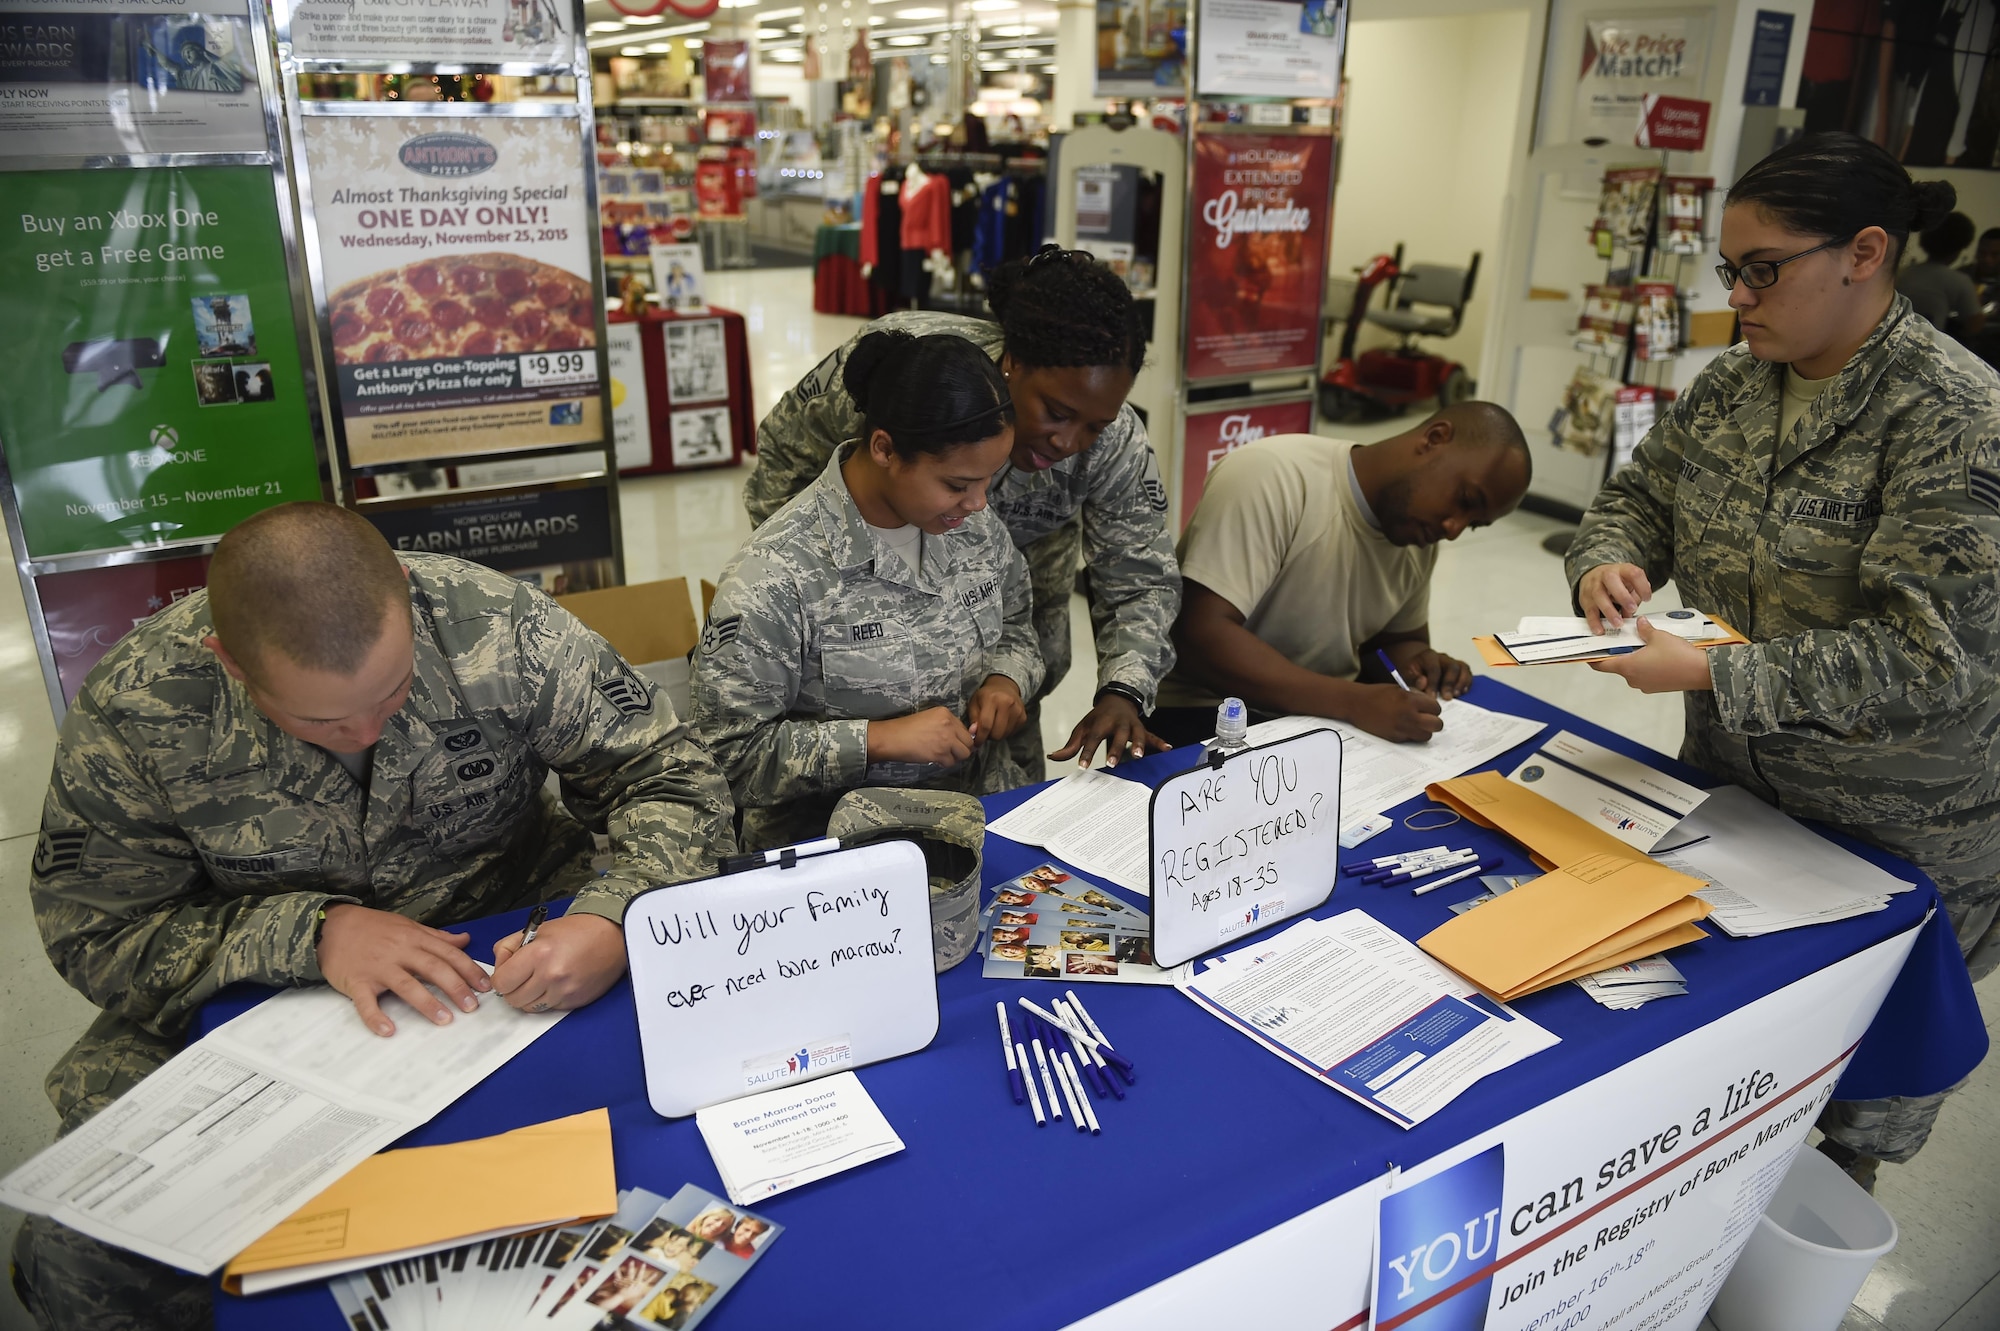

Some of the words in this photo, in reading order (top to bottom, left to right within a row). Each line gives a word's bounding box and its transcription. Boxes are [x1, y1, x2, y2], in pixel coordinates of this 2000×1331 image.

[23, 26, 76, 41] EARN
[1634, 33, 1686, 55] Price
[0, 43, 74, 58] WARDS
[1595, 51, 1684, 77] Match!
[19, 89, 49, 99] NOW
[26, 100, 71, 108] RECEIVING
[404, 145, 495, 165] ANTHONY'S
[431, 165, 469, 176] PIZZA
[1223, 169, 1303, 185] EXTENDED
[332, 188, 396, 205] Almost
[399, 186, 509, 205] Thanksgiving
[513, 185, 568, 202] Special
[1242, 187, 1288, 203] PRICE
[21, 214, 66, 236] Buy
[74, 215, 102, 231] an
[108, 209, 167, 230] Xbox
[172, 208, 219, 228] One
[358, 209, 414, 229] ONE
[421, 208, 468, 228] DAY
[477, 206, 549, 225] ONLY!
[1203, 190, 1311, 250] Guarantee
[340, 233, 433, 250] Wednesday,
[436, 230, 511, 245] November
[515, 230, 535, 244] 25,
[538, 228, 568, 242] 2015
[36, 250, 75, 272] get
[82, 249, 94, 266] a
[102, 245, 153, 265] Free
[159, 244, 225, 263] Game
[353, 367, 380, 381] Get
[382, 369, 391, 379] a
[392, 365, 431, 380] Large
[432, 357, 517, 375] One-Topping
[528, 354, 584, 375] $9.99
[356, 380, 426, 397] Anthony's
[427, 377, 462, 390] Pizza
[463, 375, 483, 388] for
[484, 373, 514, 388] only
[131, 451, 174, 469] XBOX
[174, 449, 207, 464] ONE
[66, 496, 146, 517] November
[151, 494, 169, 508] 15
[185, 484, 261, 504] November
[264, 481, 282, 496] 21
[1795, 498, 1818, 516] U.S.
[1820, 501, 1841, 521] AIR
[453, 516, 478, 526] NOW
[479, 513, 499, 524] YOU
[501, 511, 522, 521] CAN
[1012, 504, 1033, 517] U.S.
[1036, 507, 1055, 521] AIR
[397, 529, 463, 551] EARN
[468, 514, 580, 545] REWARDS
[461, 547, 490, 558] EVERY
[491, 540, 539, 554] PURCHASE
[961, 587, 982, 608] U.S.
[980, 582, 994, 600] AIR
[852, 622, 885, 642] REED
[1181, 775, 1226, 826] ARE
[1249, 754, 1298, 806] YOU
[428, 802, 458, 819] U.S.
[464, 792, 488, 810] AIR
[1600, 806, 1614, 816] LIFE
[1613, 811, 1624, 823] TO
[1634, 824, 1659, 839] SALUTE
[1161, 792, 1324, 897] REGISTERED?
[1191, 886, 1221, 912] Ages
[1227, 861, 1279, 899] 18-35
[648, 911, 718, 946] Will
[733, 906, 795, 956] your
[1220, 919, 1246, 937] SALUTE
[1260, 909, 1271, 919] TO
[1272, 904, 1286, 916] LIFE
[666, 983, 715, 1009] ever
[725, 968, 767, 997] need
[777, 959, 821, 979] bone
[830, 928, 903, 968] marrow?
[1404, 1032, 1418, 1042] 2
[746, 1066, 789, 1087] SALUTE
[811, 1054, 829, 1070] TO
[830, 1049, 852, 1067] LIFE
[1344, 1068, 1358, 1080] 1
[733, 1115, 761, 1130] Bone
[763, 1100, 803, 1119] Marrow
[805, 1089, 837, 1105] Donor
[743, 1110, 808, 1137] Recruitment
[810, 1100, 838, 1115] Drive
[753, 1132, 792, 1151] November
[1389, 1207, 1499, 1301] YOU
[1510, 1174, 1585, 1237] can
[1595, 1125, 1683, 1192] save
[1691, 1104, 1710, 1137] a
[1719, 1070, 1779, 1123] life.
[1498, 1263, 1546, 1311] Join
[1553, 1244, 1588, 1277] the
[1595, 1189, 1677, 1251] Registry
[1679, 1168, 1703, 1197] of
[1703, 1142, 1750, 1183] Bone
[1752, 1096, 1818, 1151] Marrow
[1626, 1293, 1647, 1315] and
[1647, 1266, 1686, 1300] Medical
[1685, 1248, 1714, 1272] Group
